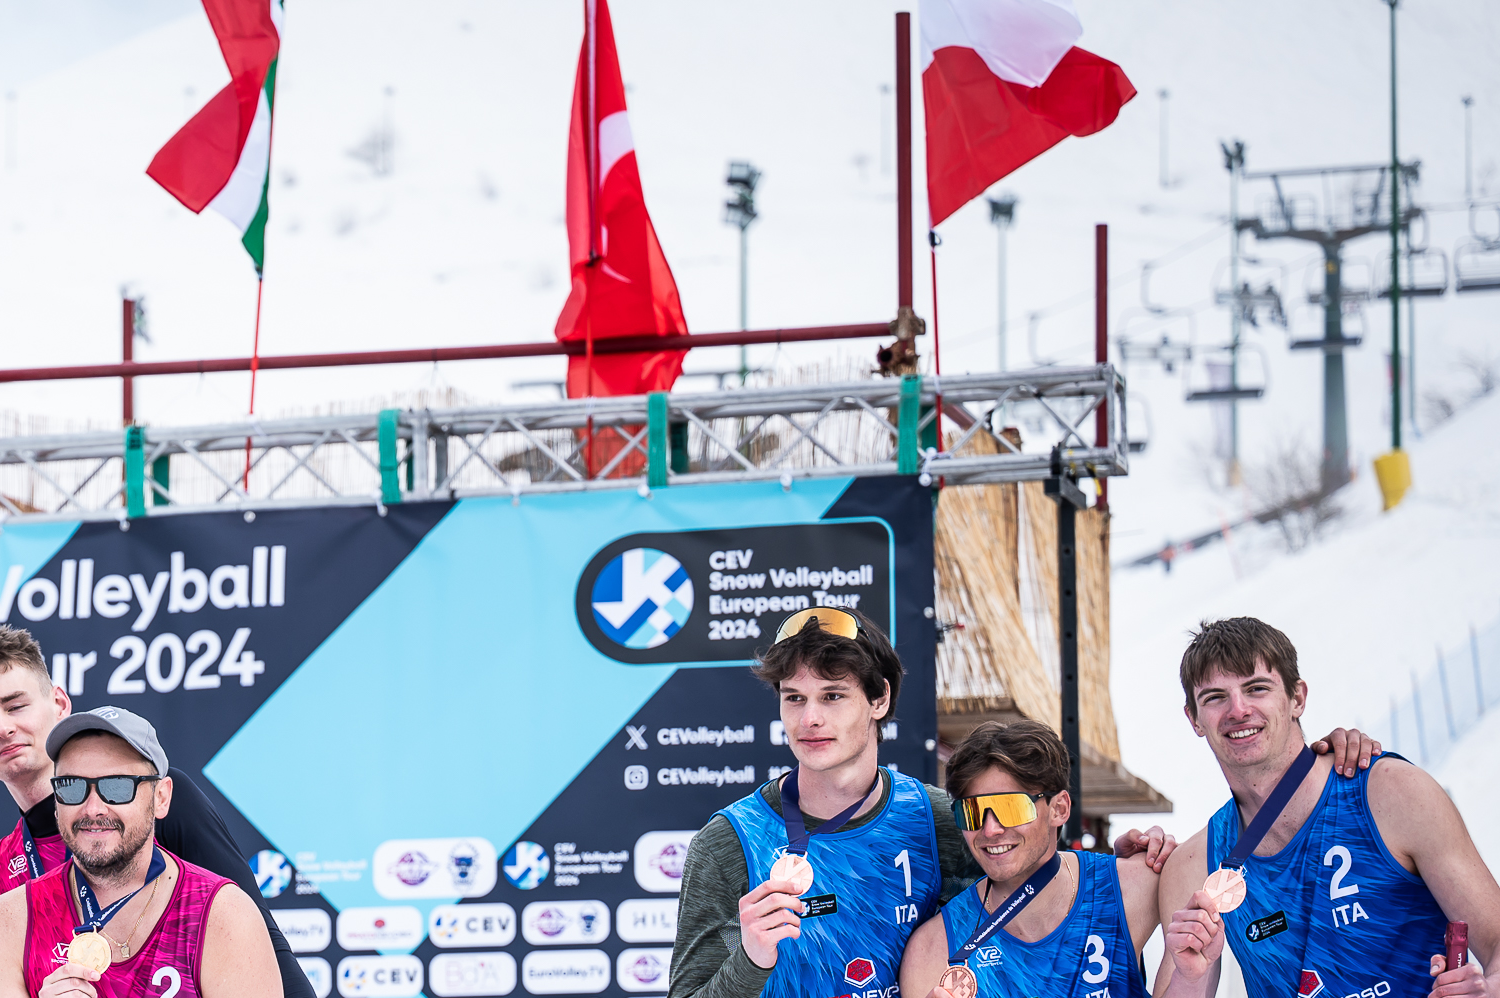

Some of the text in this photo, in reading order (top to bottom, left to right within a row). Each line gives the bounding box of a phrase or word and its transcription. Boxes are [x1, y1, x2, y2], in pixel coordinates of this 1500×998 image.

[708, 549, 753, 571] CEV
[708, 565, 873, 591] Snow Volleyball
[708, 593, 810, 616] European
[708, 619, 760, 640] 2024
[49, 650, 97, 697] ur
[106, 628, 265, 695] 2024
[657, 726, 754, 746] CEVolleyball
[657, 766, 754, 787] CEVolleyball
[894, 849, 912, 897] 1
[1324, 845, 1359, 900] 2
[466, 917, 510, 932] CEV
[894, 903, 919, 925] ITA
[1332, 901, 1369, 928] ITA
[1082, 934, 1110, 984] 3
[373, 969, 418, 984] CEV
